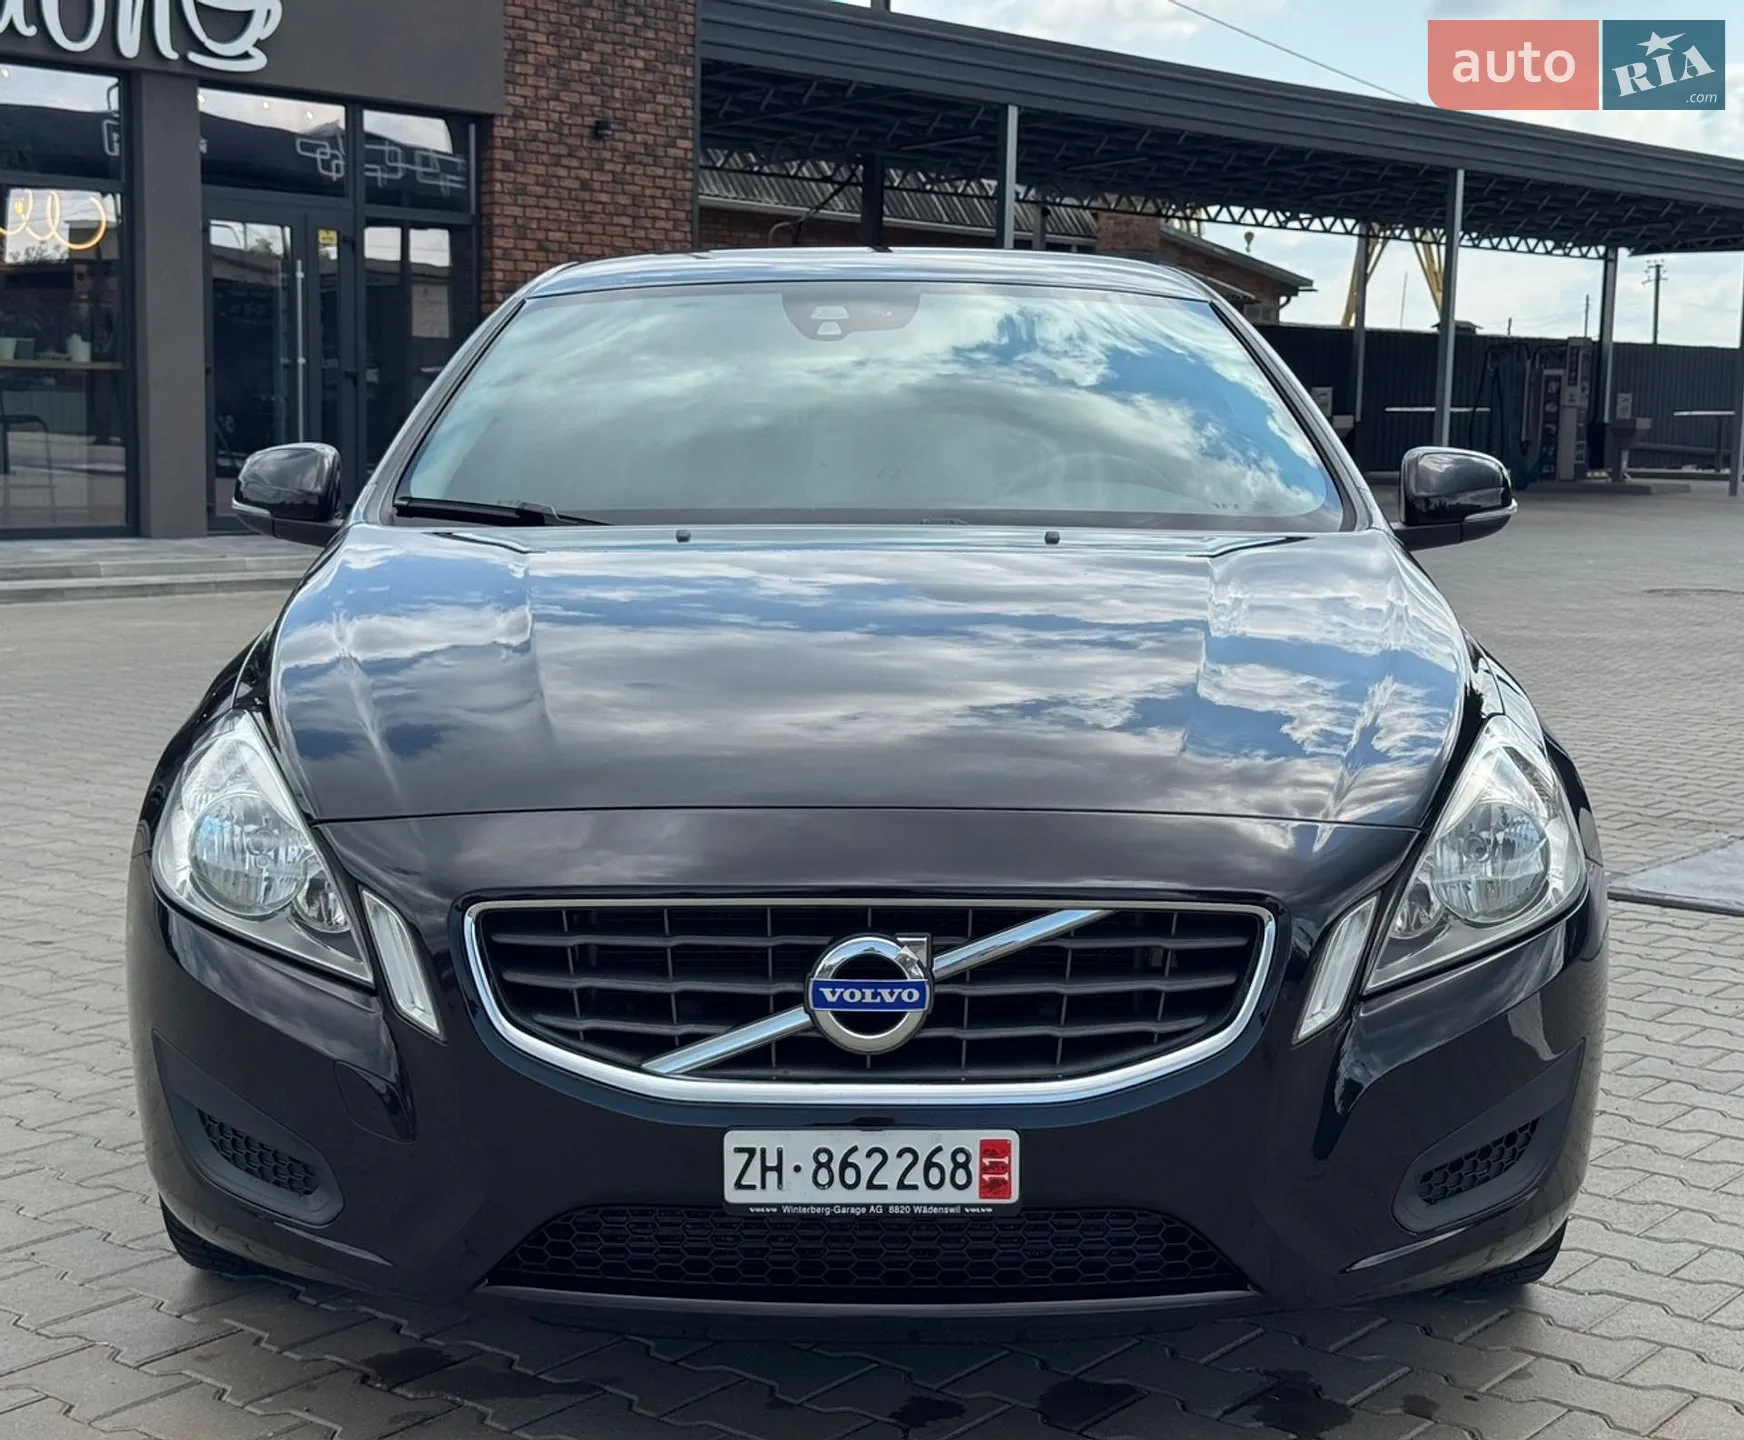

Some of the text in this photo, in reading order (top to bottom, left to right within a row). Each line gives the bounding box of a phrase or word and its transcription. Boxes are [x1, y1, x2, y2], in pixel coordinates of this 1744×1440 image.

[819, 987, 920, 1003] VOLVO
[781, 1204, 867, 1216] Winterberg-Garage
[869, 1204, 883, 1214] AG
